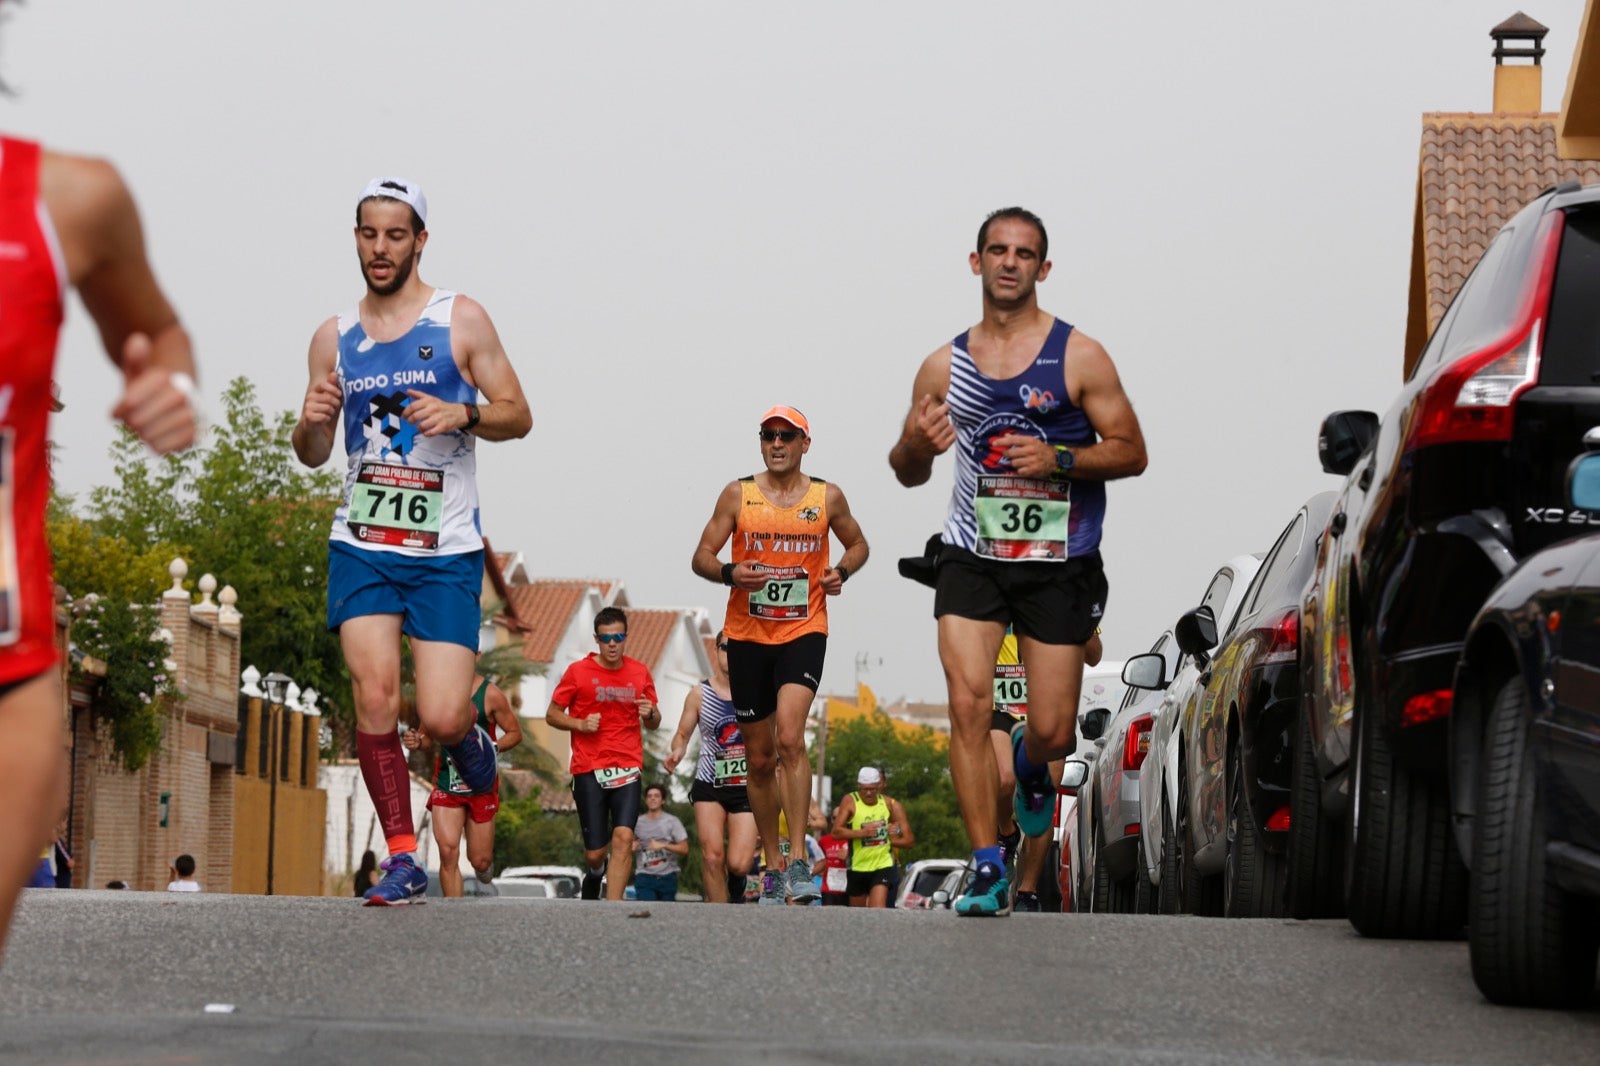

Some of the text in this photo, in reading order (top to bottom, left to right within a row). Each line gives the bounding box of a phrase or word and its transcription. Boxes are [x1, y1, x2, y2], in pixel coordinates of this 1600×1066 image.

[346, 370, 437, 394] TODO SUMA
[375, 465, 390, 477] GRAN
[390, 468, 412, 480] PREMIO
[413, 470, 421, 481] DE
[367, 489, 428, 524] 716
[1001, 502, 1043, 533] 36
[744, 531, 764, 551] LA
[751, 531, 818, 541] Club Deportivo
[767, 582, 793, 602] 87
[723, 760, 748, 775] 120
[372, 749, 402, 831] kalenji
